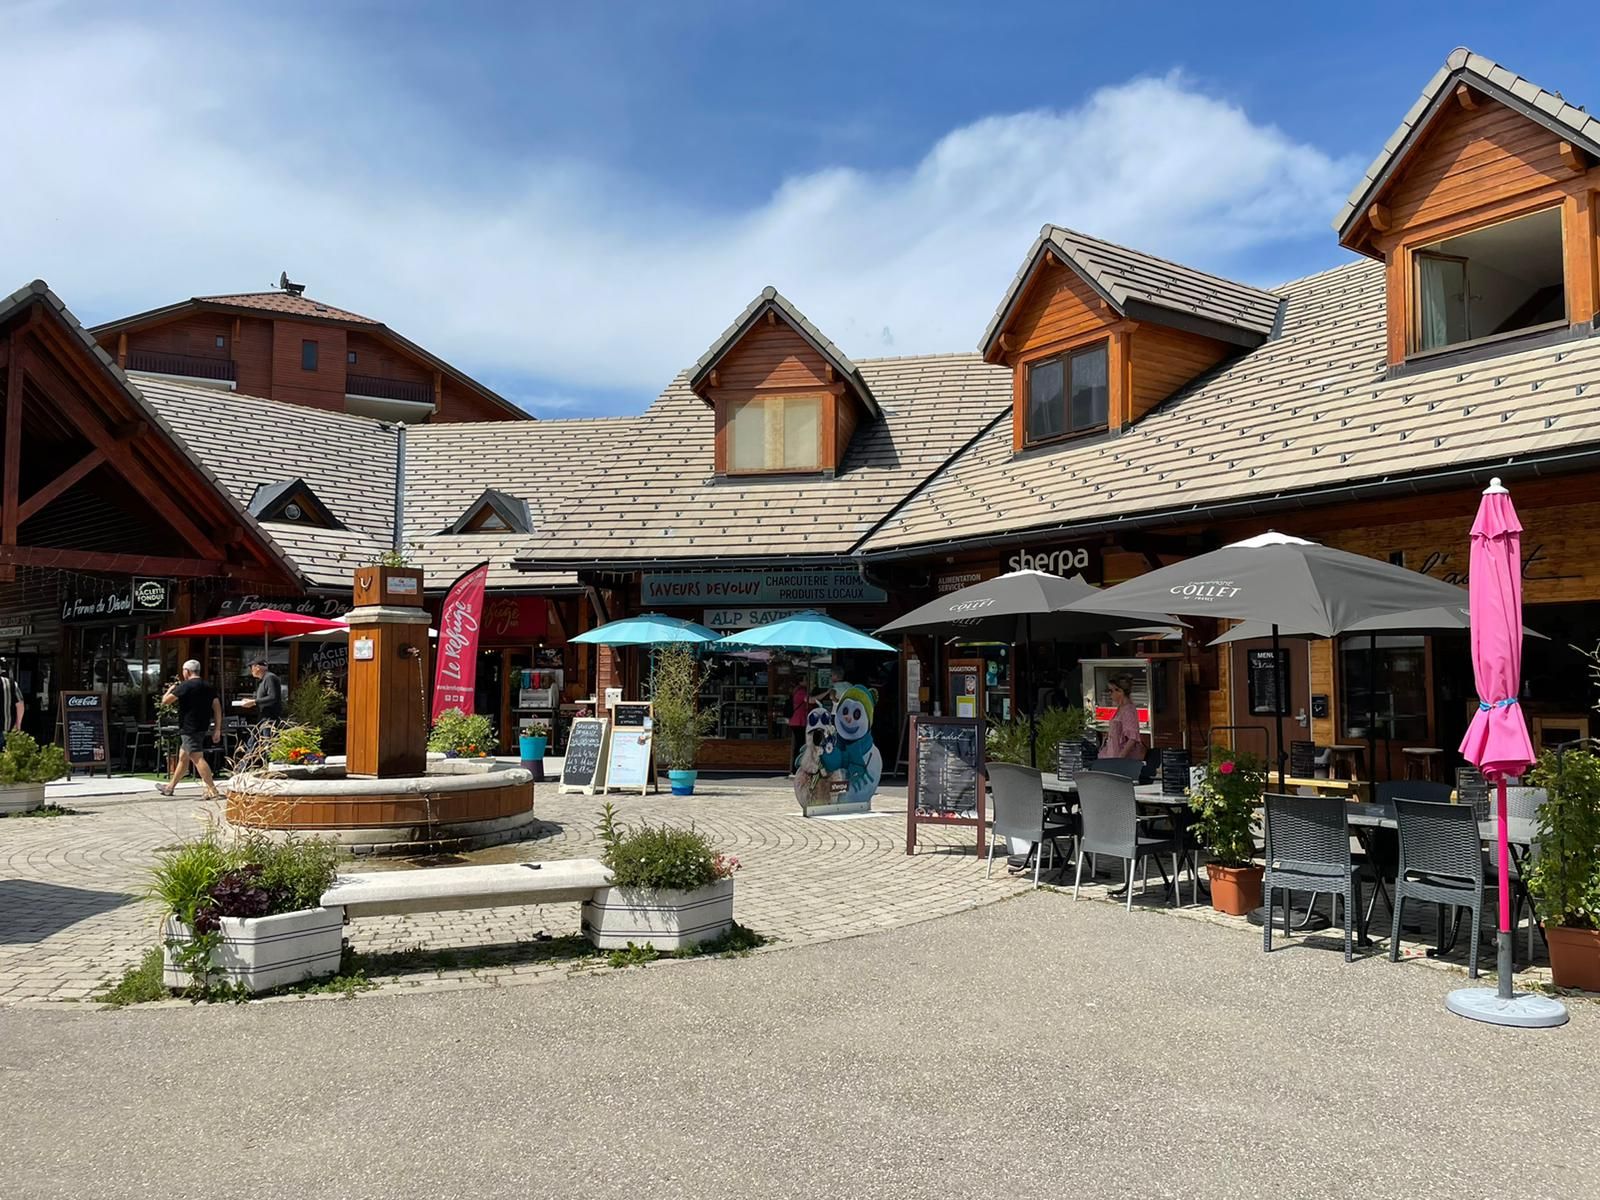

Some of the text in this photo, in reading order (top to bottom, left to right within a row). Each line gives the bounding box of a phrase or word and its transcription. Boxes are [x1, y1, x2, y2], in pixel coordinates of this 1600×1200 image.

[1009, 548, 1088, 576] sherpa
[765, 575, 829, 587] CHARCUTERIE
[938, 573, 981, 586] ALIMENTATION
[135, 588, 165, 597] RACLETTE
[649, 582, 701, 598] SAVEURS
[779, 588, 864, 600] PRODUITS LOCAUX
[938, 583, 966, 592] SERVICES
[1170, 585, 1242, 598] COLLET
[137, 594, 165, 602] FONDUE
[238, 595, 292, 612] Ferme
[296, 600, 316, 613] du
[73, 598, 96, 617] Ferme
[711, 611, 743, 625] ALP
[444, 600, 478, 659] Refuge
[441, 662, 461, 680] Le
